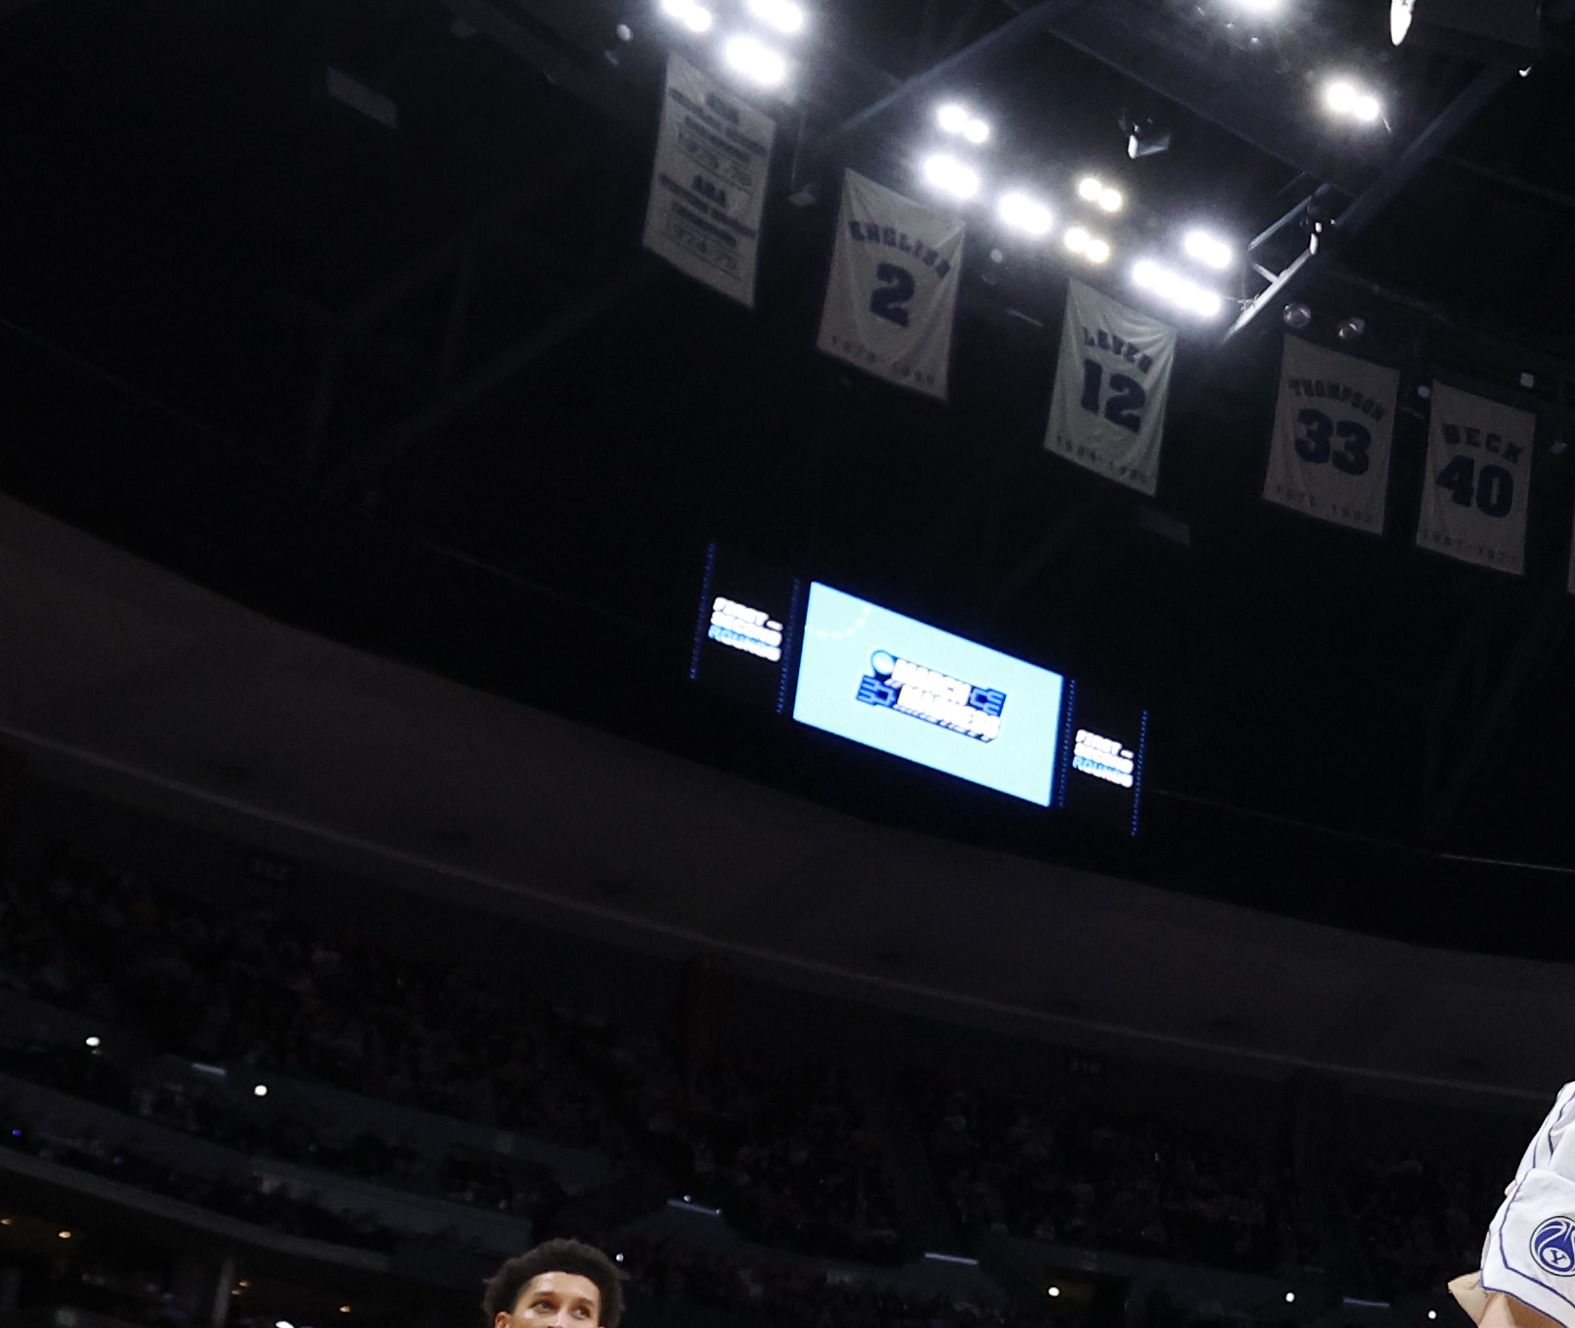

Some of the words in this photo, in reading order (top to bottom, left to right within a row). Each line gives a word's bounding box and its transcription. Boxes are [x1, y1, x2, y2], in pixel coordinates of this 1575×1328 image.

[869, 262, 915, 328] 2
[1081, 358, 1147, 434] 12
[1295, 408, 1371, 476] 33
[1435, 455, 1514, 518] 40
